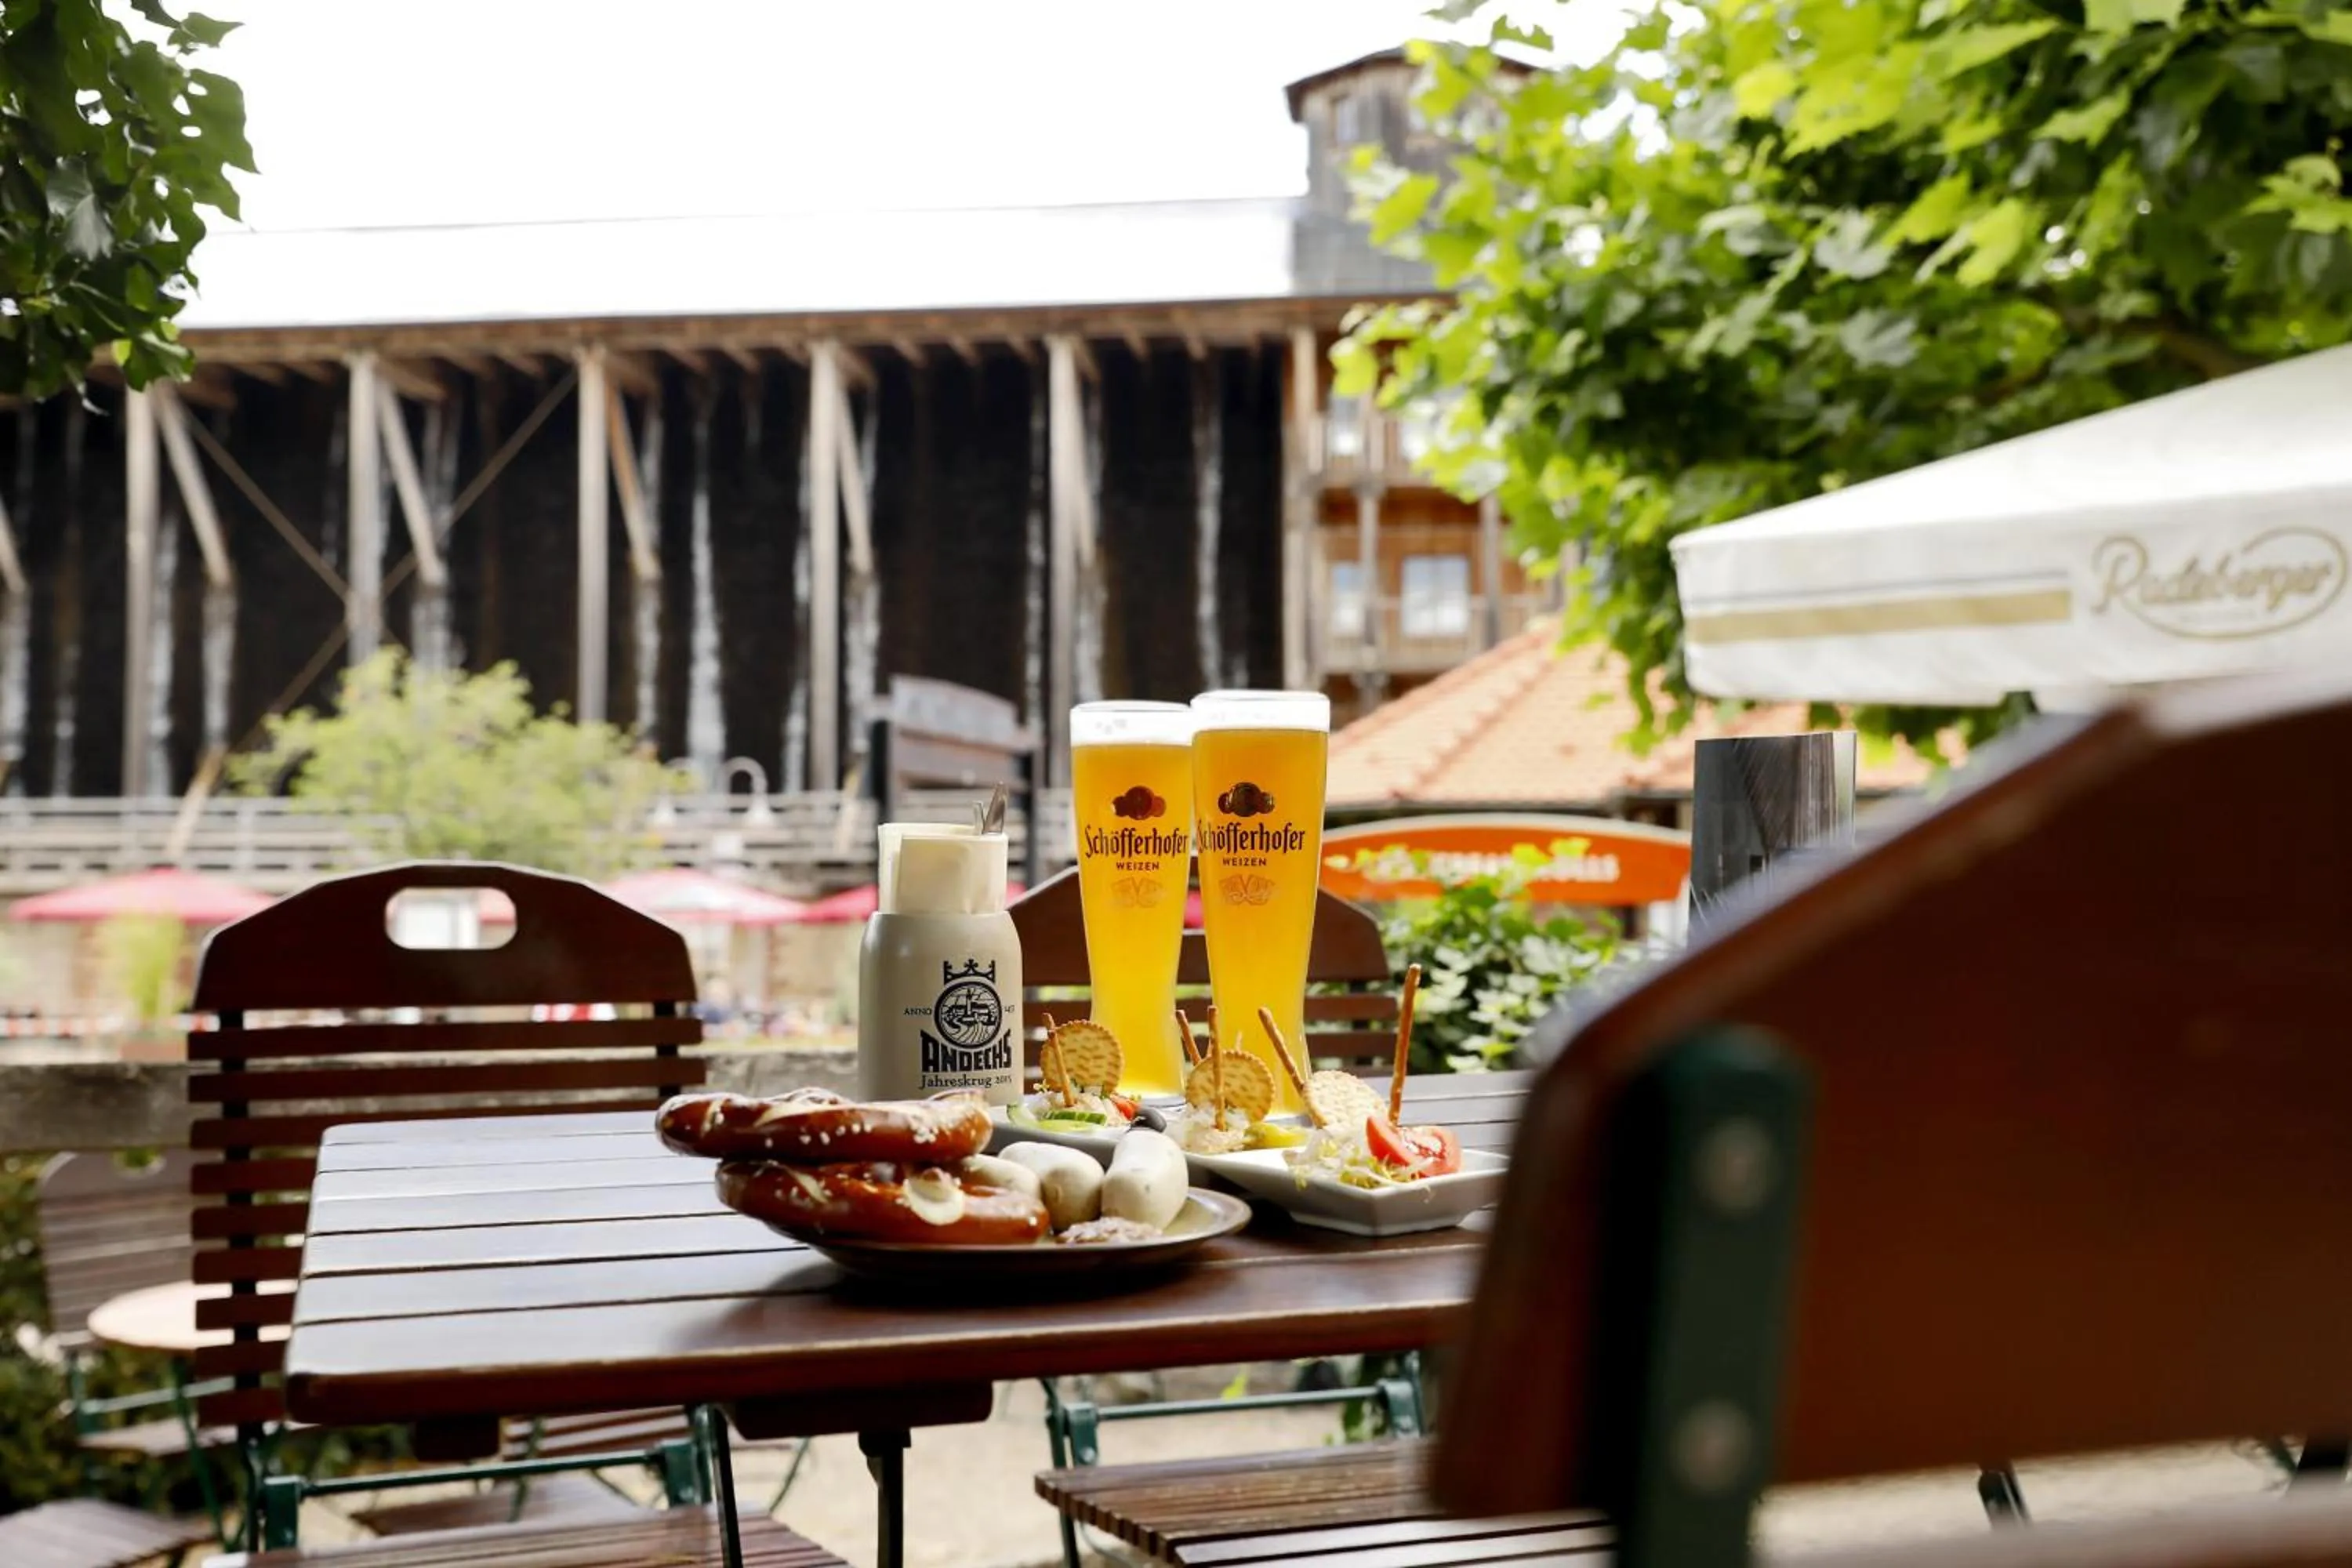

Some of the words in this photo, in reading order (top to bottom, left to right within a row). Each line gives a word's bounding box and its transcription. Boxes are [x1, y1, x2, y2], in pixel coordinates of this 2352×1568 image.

[1084, 825, 1189, 858] Schöfferhofer
[1116, 862, 1160, 871] WEIZEN
[1222, 858, 1267, 866] WEIZEN
[920, 1029, 1012, 1073] ANDECHS
[918, 1073, 992, 1091] Jahreskrug
